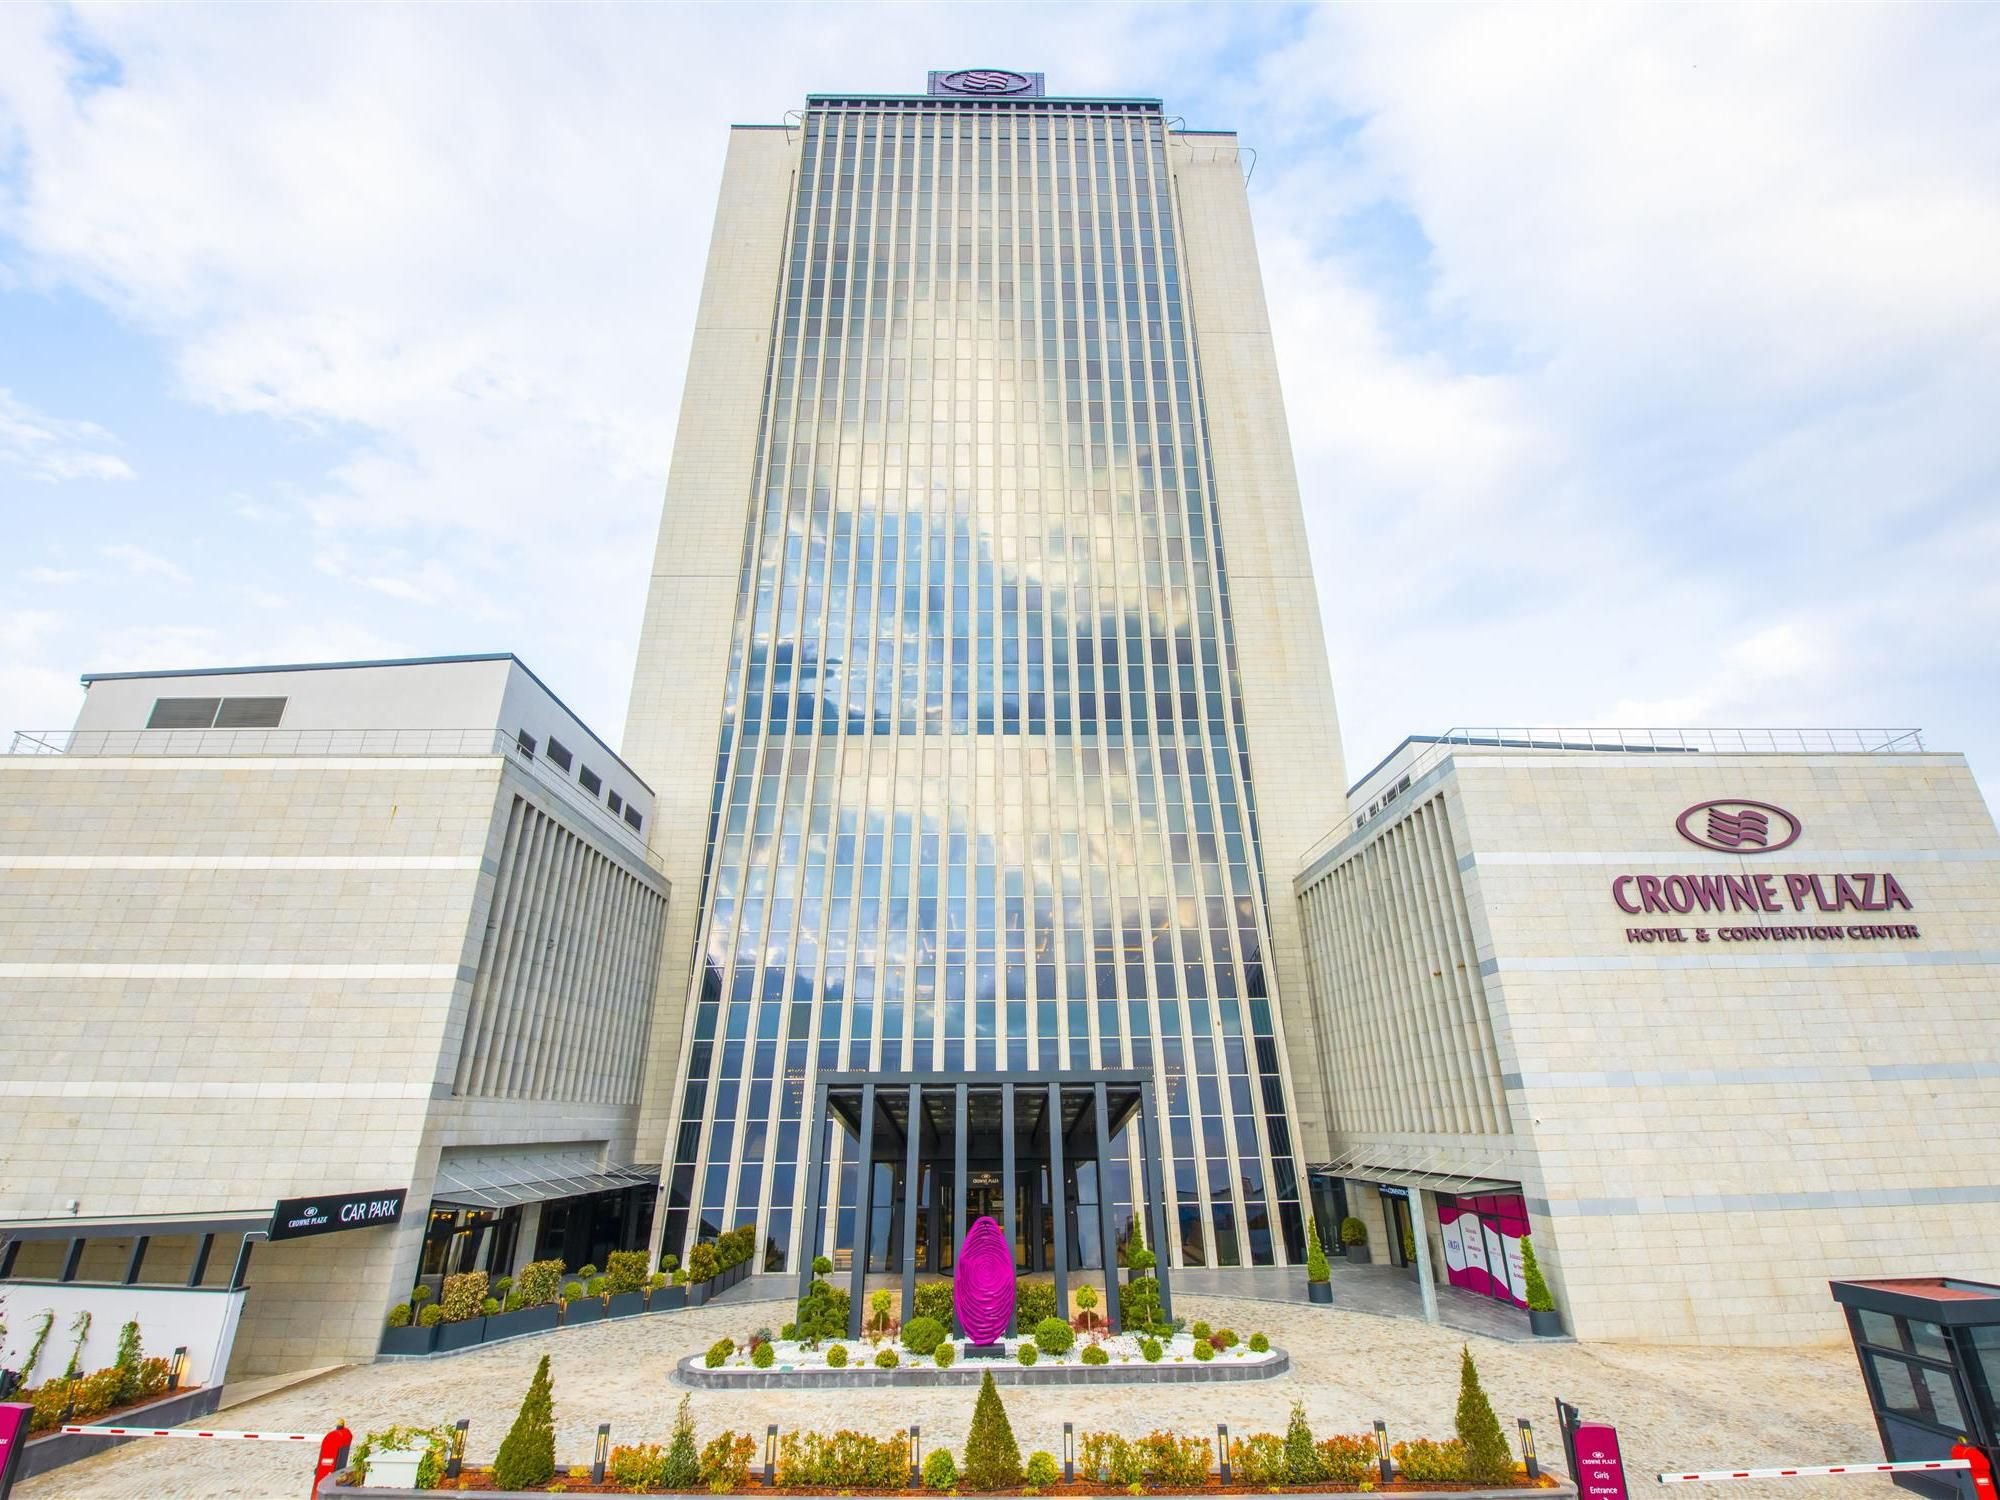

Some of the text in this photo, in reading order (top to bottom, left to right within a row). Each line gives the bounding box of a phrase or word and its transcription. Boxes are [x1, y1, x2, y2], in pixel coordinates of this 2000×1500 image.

[1612, 872, 1914, 913] CROWNE PLAZA
[1626, 924, 1921, 943] HOTEL & CONVENTION CENTER
[340, 1199, 398, 1222] CAR PARK
[288, 1216, 328, 1228] CROWNE PLAZA
[1589, 1486, 1618, 1495] Entrance
